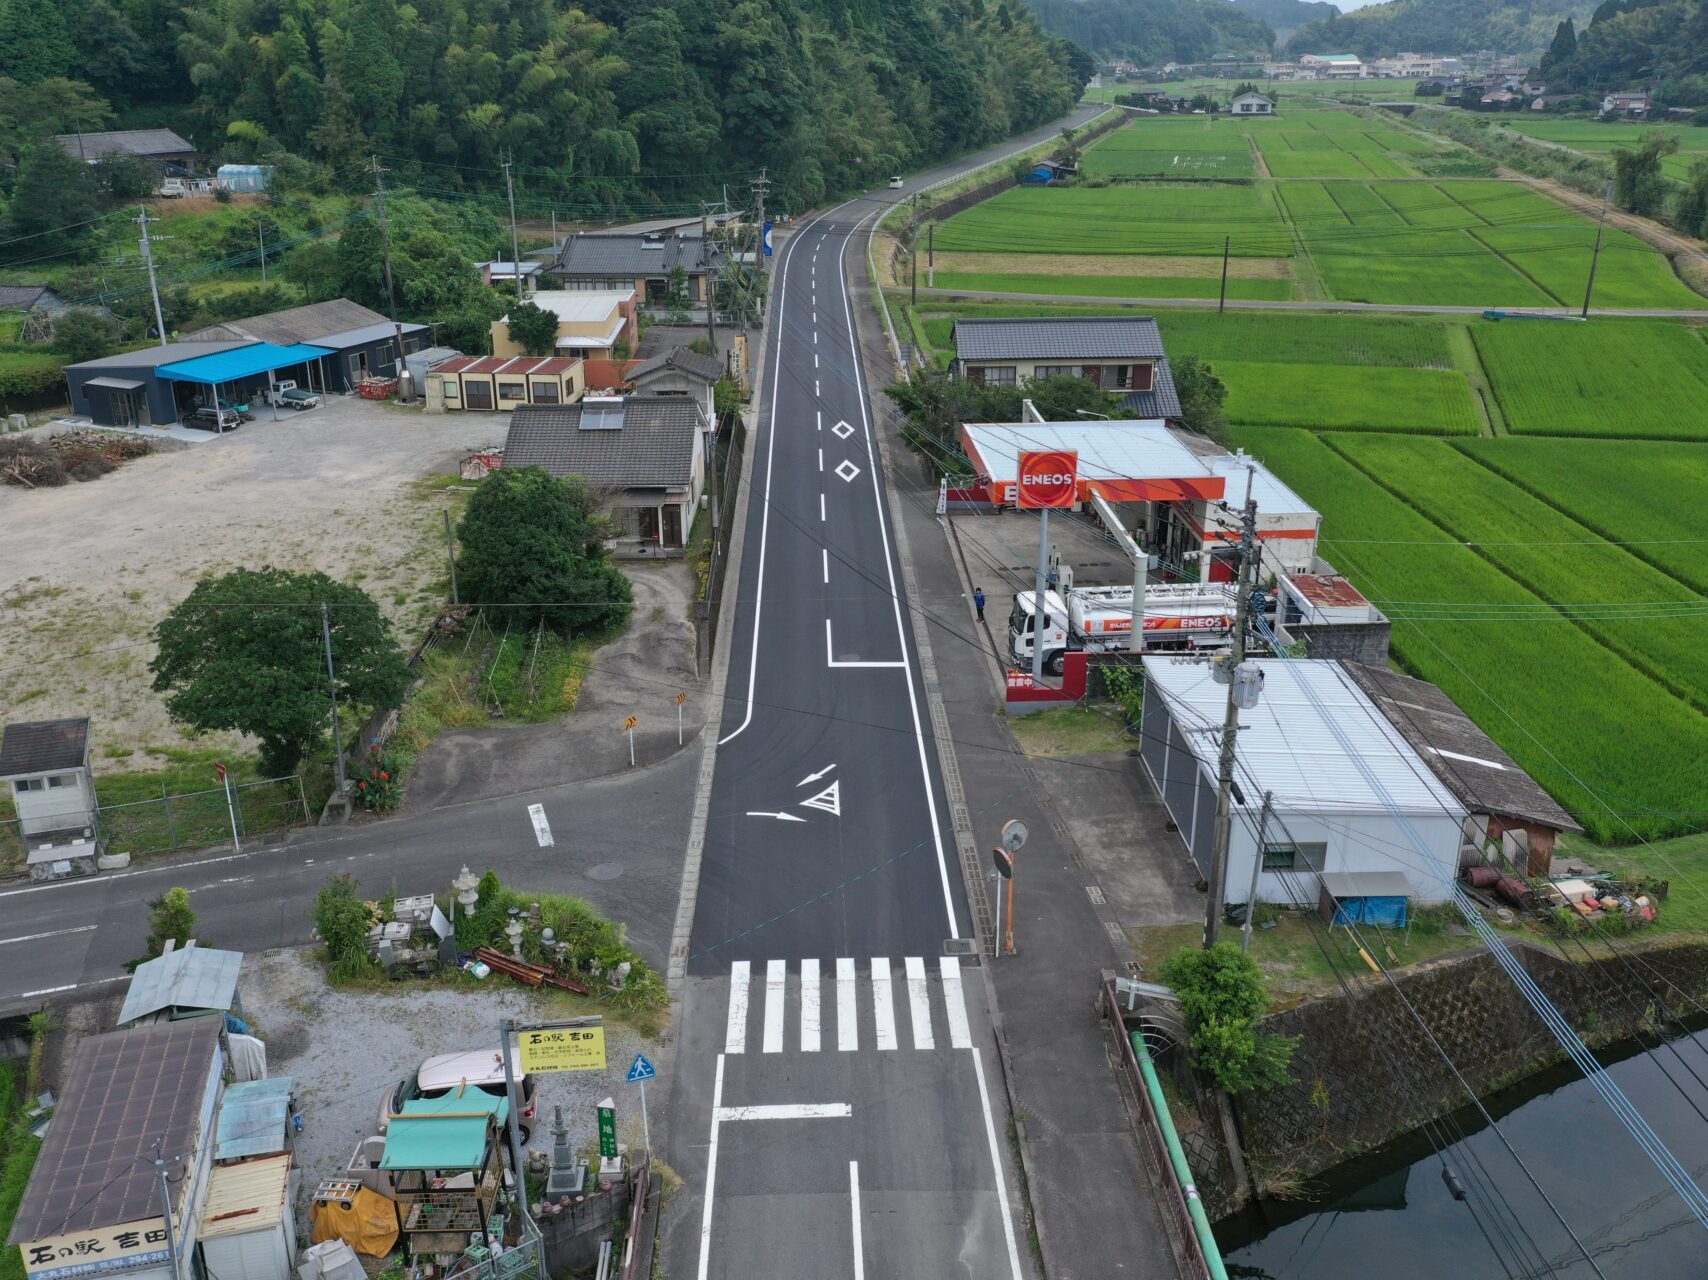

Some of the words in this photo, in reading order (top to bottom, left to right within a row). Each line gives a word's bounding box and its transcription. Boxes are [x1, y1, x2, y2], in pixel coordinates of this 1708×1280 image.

[1022, 473, 1072, 485] ENEOS
[1180, 617, 1222, 628] ENEOS
[1008, 678, 1033, 687] 営業中
[529, 1032, 565, 1045] 石の駅
[568, 1031, 594, 1041] 吉田
[29, 1239, 107, 1265] 石の駅
[113, 1228, 168, 1249] 吉田
[128, 1251, 170, 1265] 294-261
